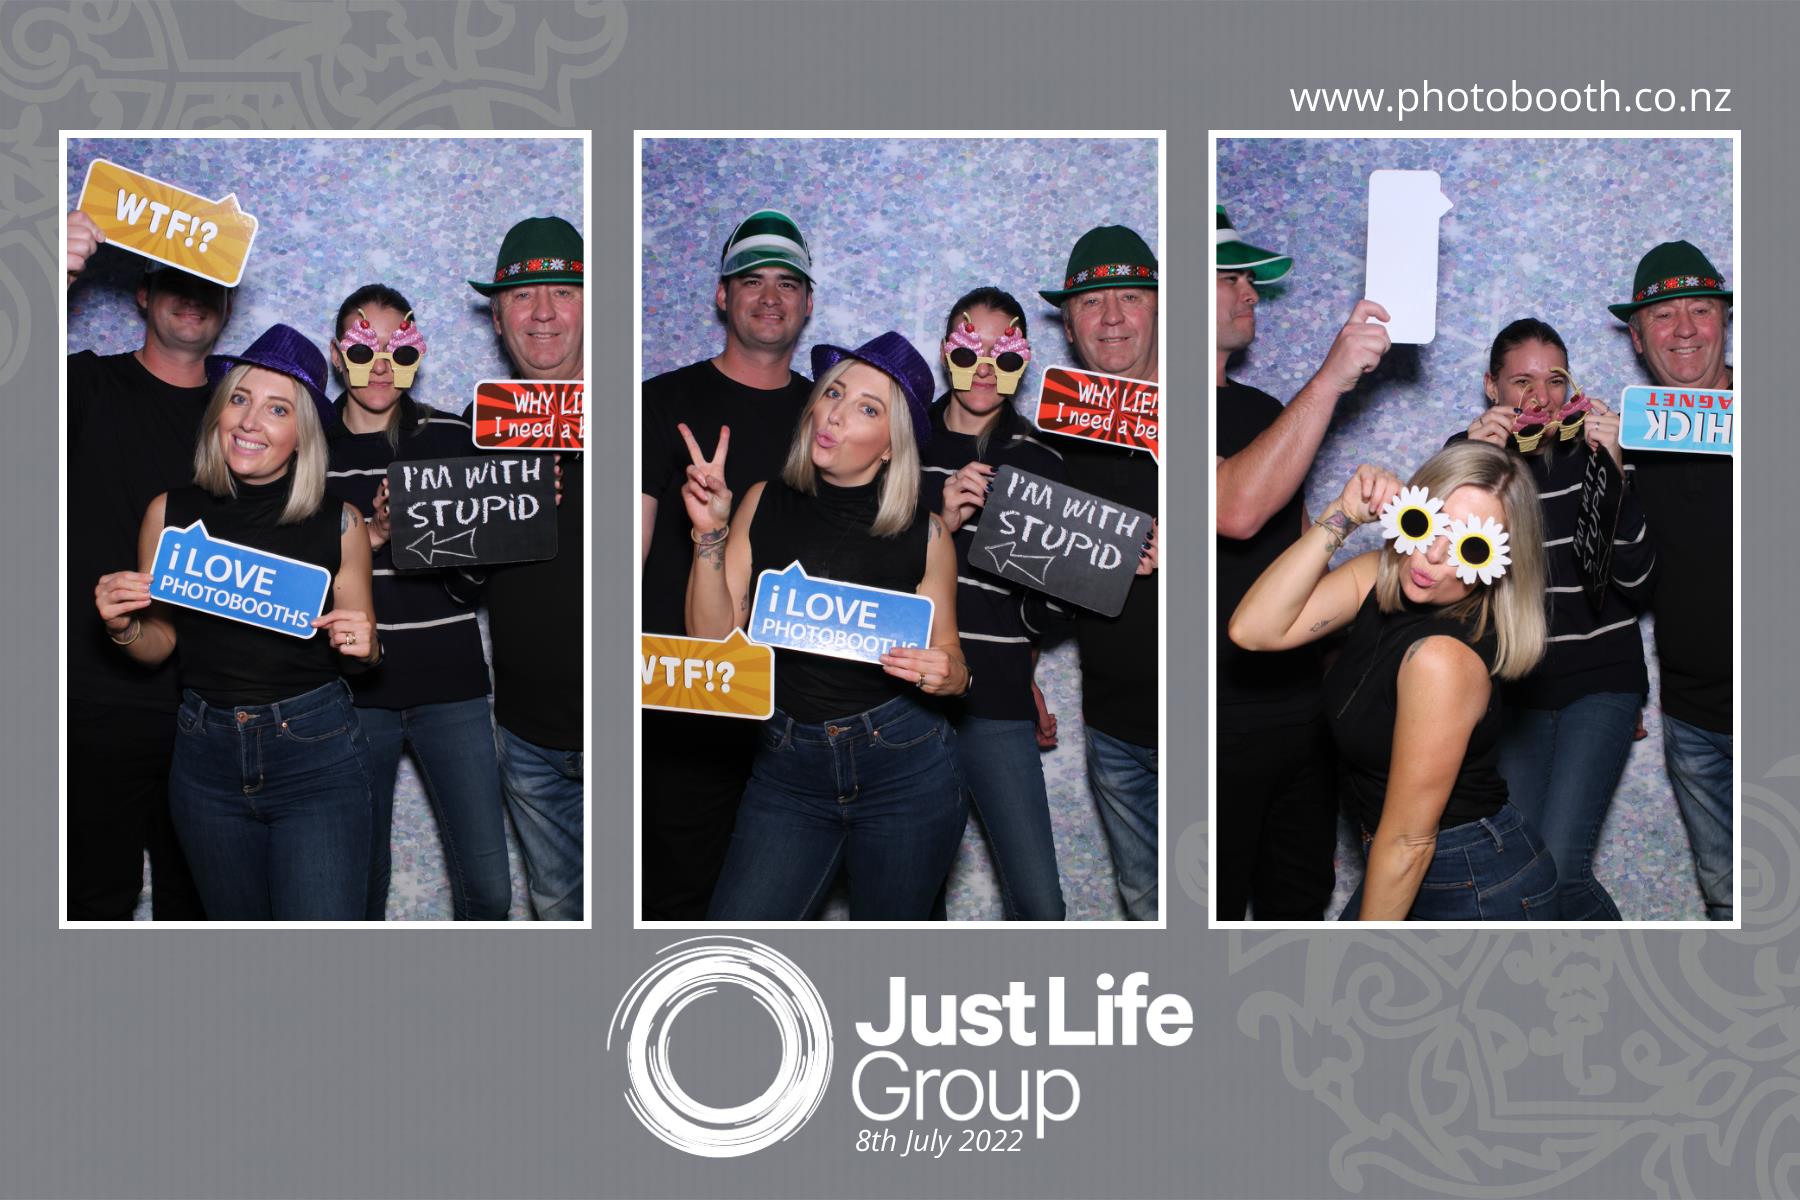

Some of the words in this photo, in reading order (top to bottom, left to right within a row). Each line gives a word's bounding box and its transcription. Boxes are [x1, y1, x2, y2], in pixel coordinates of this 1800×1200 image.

[115, 188, 219, 254] WTF!?
[512, 391, 554, 416] WHY
[560, 391, 584, 415] LI
[1078, 380, 1117, 410] WHY
[495, 416, 503, 437] I
[508, 415, 556, 438] need
[561, 423, 571, 438] a
[1055, 402, 1065, 423] I
[1069, 409, 1115, 433] need
[1117, 420, 1128, 436] a
[403, 464, 454, 492] I'M
[1007, 472, 1054, 510] I'M
[184, 547, 277, 597] LOVE
[159, 574, 311, 629] PHOTOBOOTHS
[785, 588, 880, 630] LOVE
